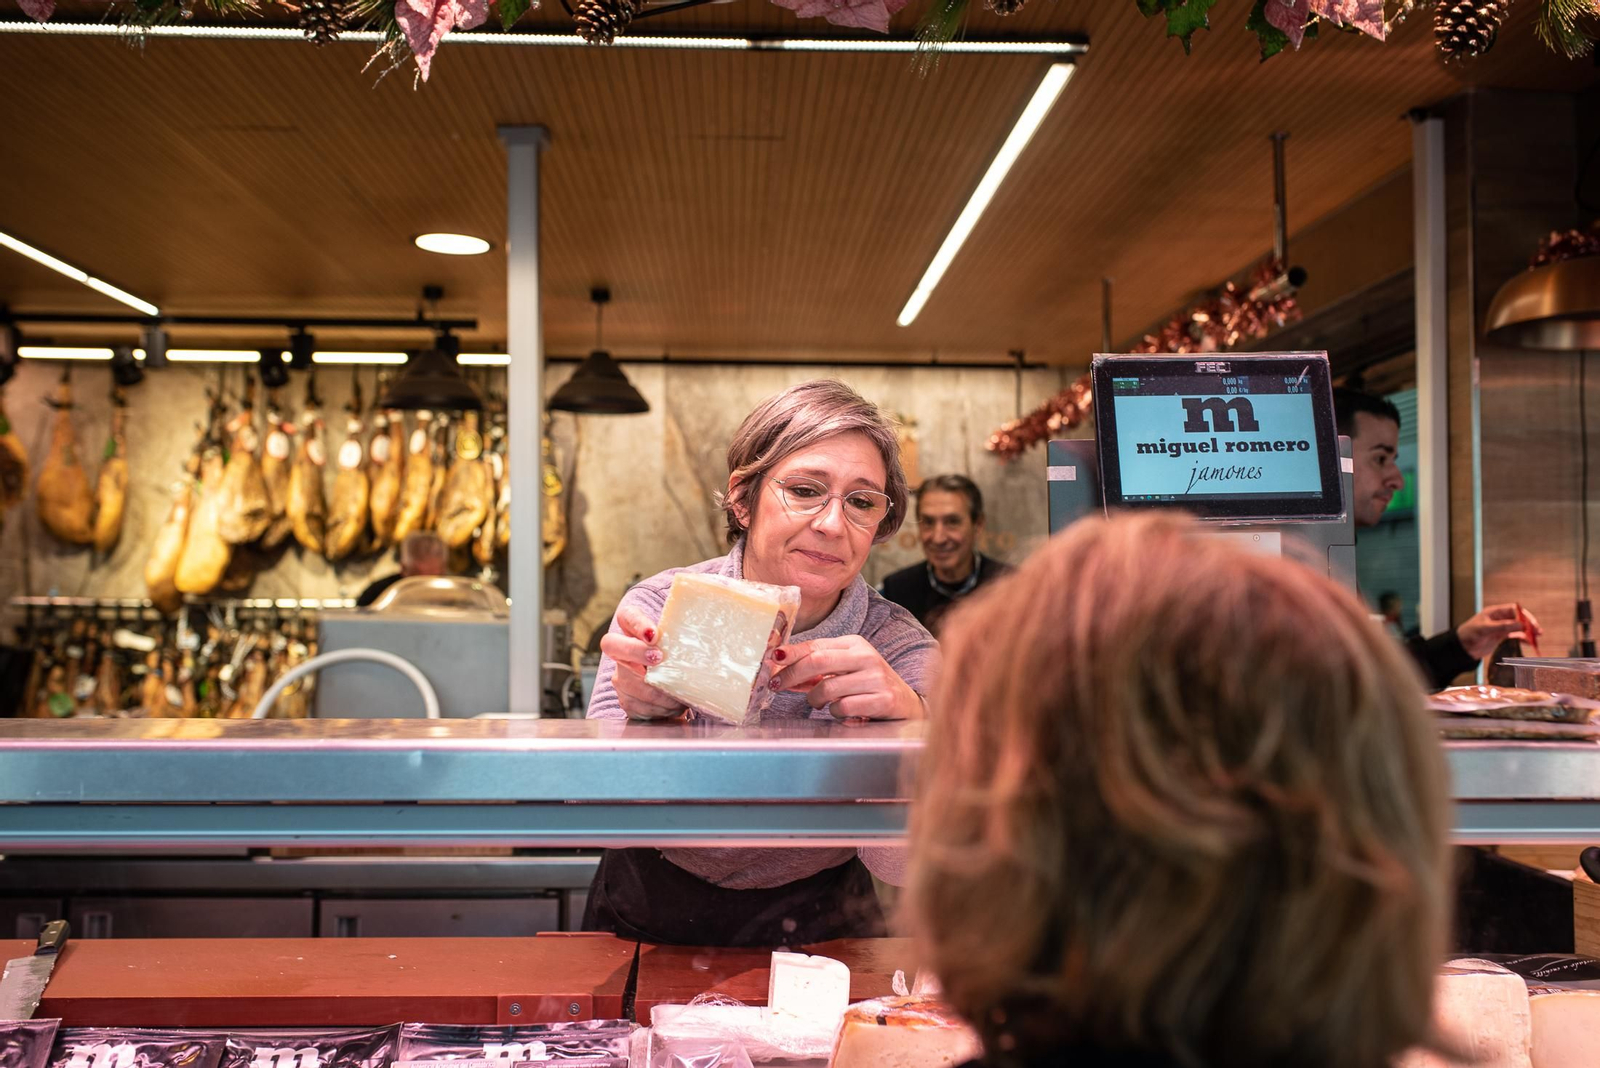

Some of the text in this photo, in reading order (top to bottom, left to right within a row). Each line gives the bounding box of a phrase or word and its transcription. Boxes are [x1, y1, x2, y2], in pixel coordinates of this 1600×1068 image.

[1181, 396, 1260, 433] m
[1136, 437, 1310, 458] miguel romero
[1185, 460, 1263, 495] jamones
[483, 1040, 553, 1060] m
